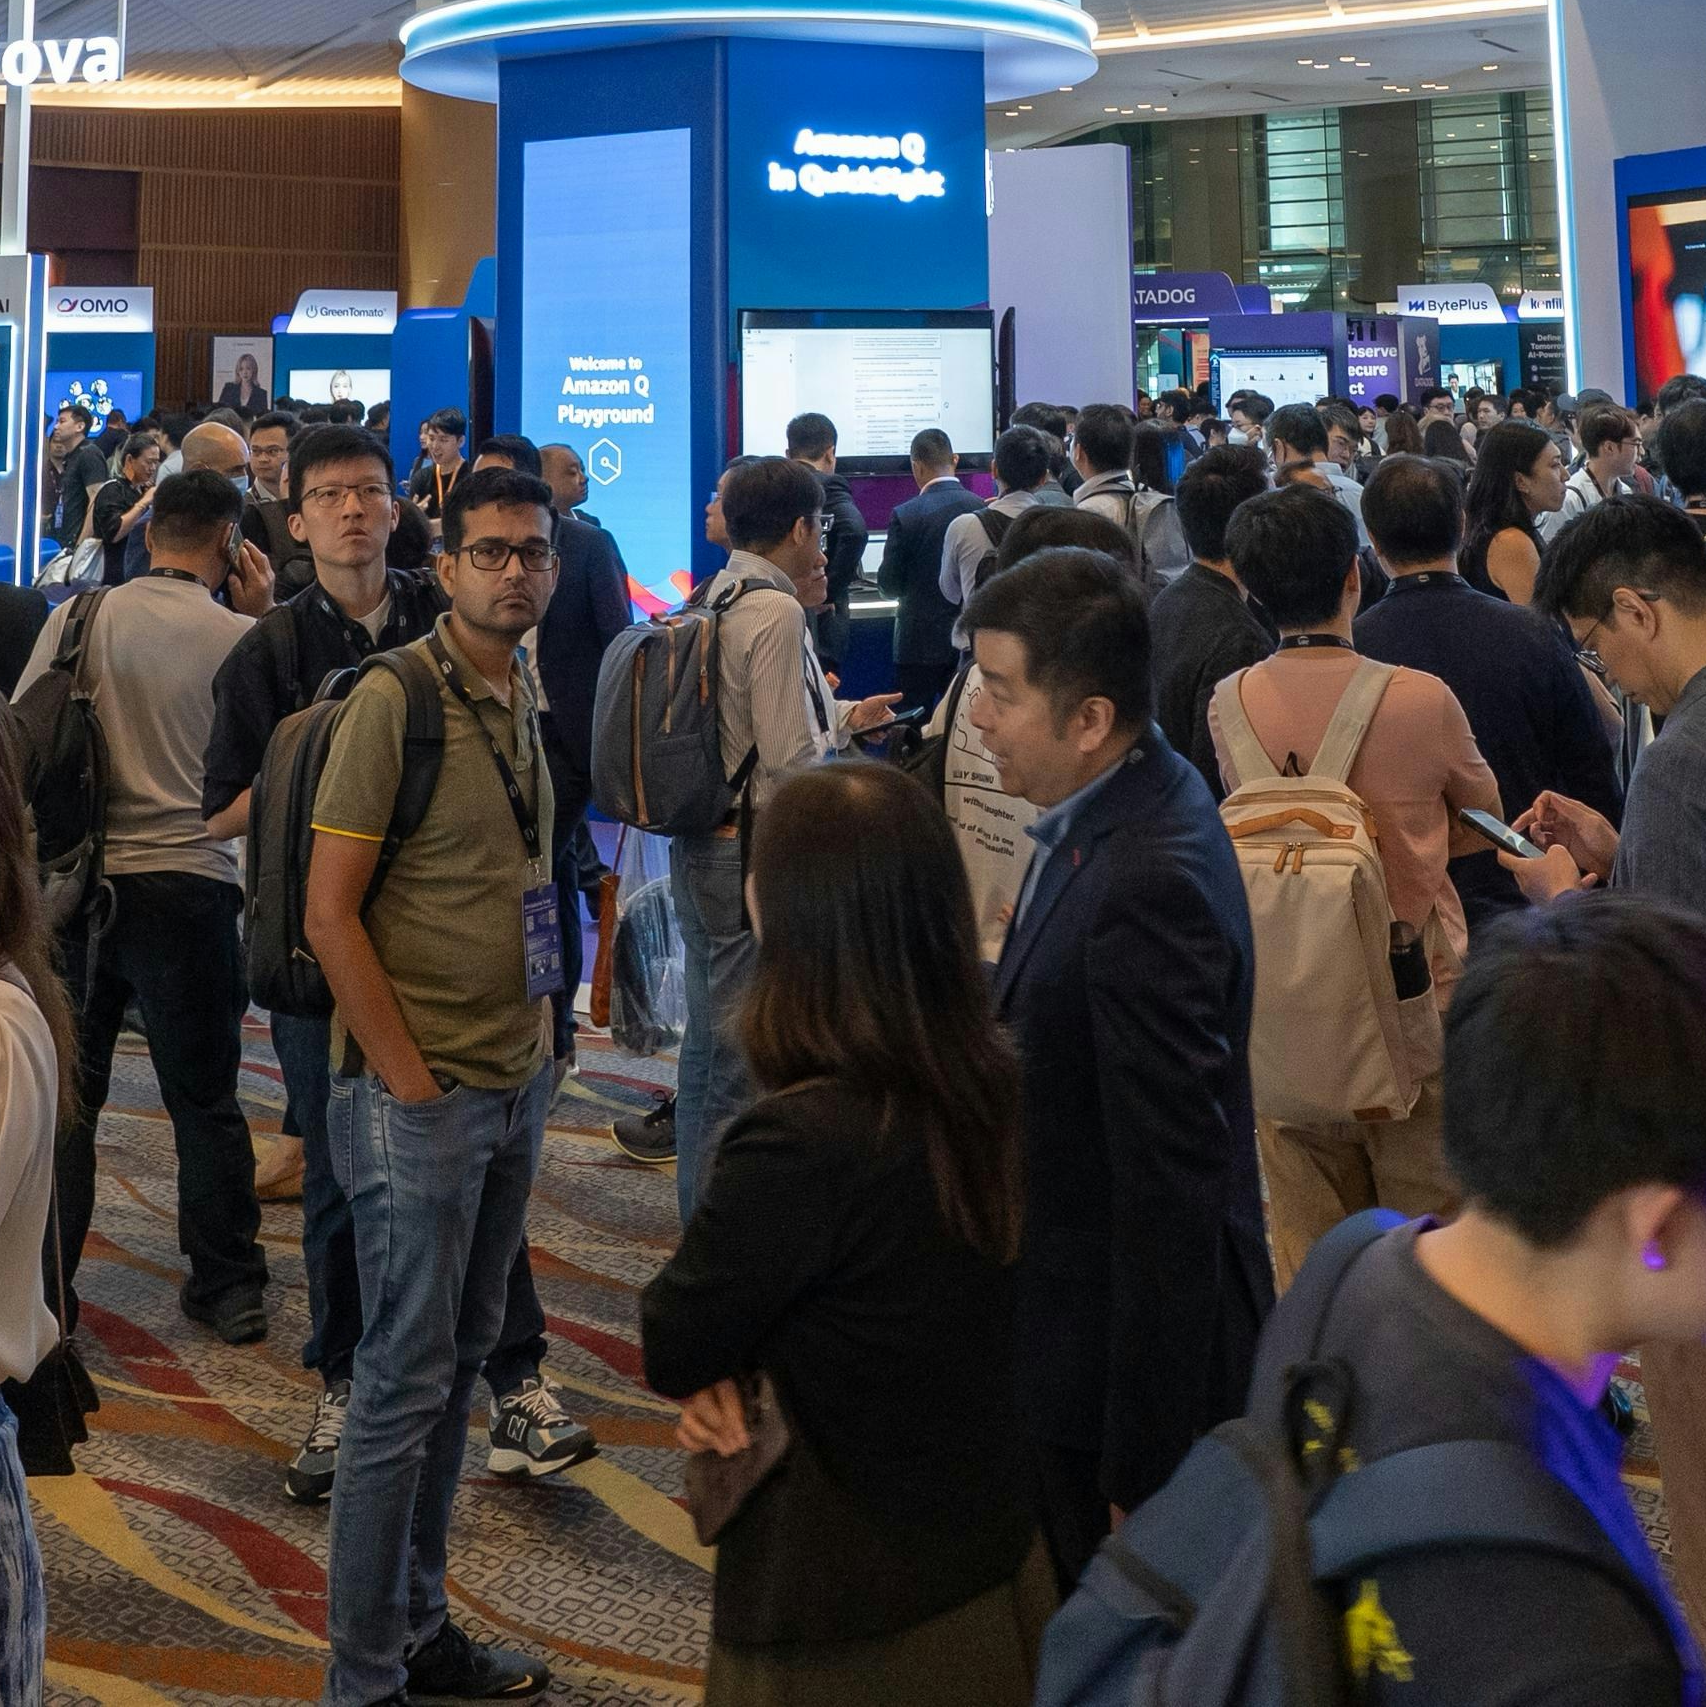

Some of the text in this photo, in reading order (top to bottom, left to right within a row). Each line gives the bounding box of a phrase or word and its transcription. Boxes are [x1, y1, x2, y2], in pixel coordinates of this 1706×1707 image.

[901, 132, 926, 165] Q
[768, 161, 797, 191] in
[81, 299, 128, 313] OMO
[1428, 299, 1488, 314] BytePlus
[569, 356, 642, 371] Welcome to
[1528, 351, 1566, 359] AI-Power
[561, 375, 650, 398] Amazon Q
[558, 403, 654, 428] Playground
